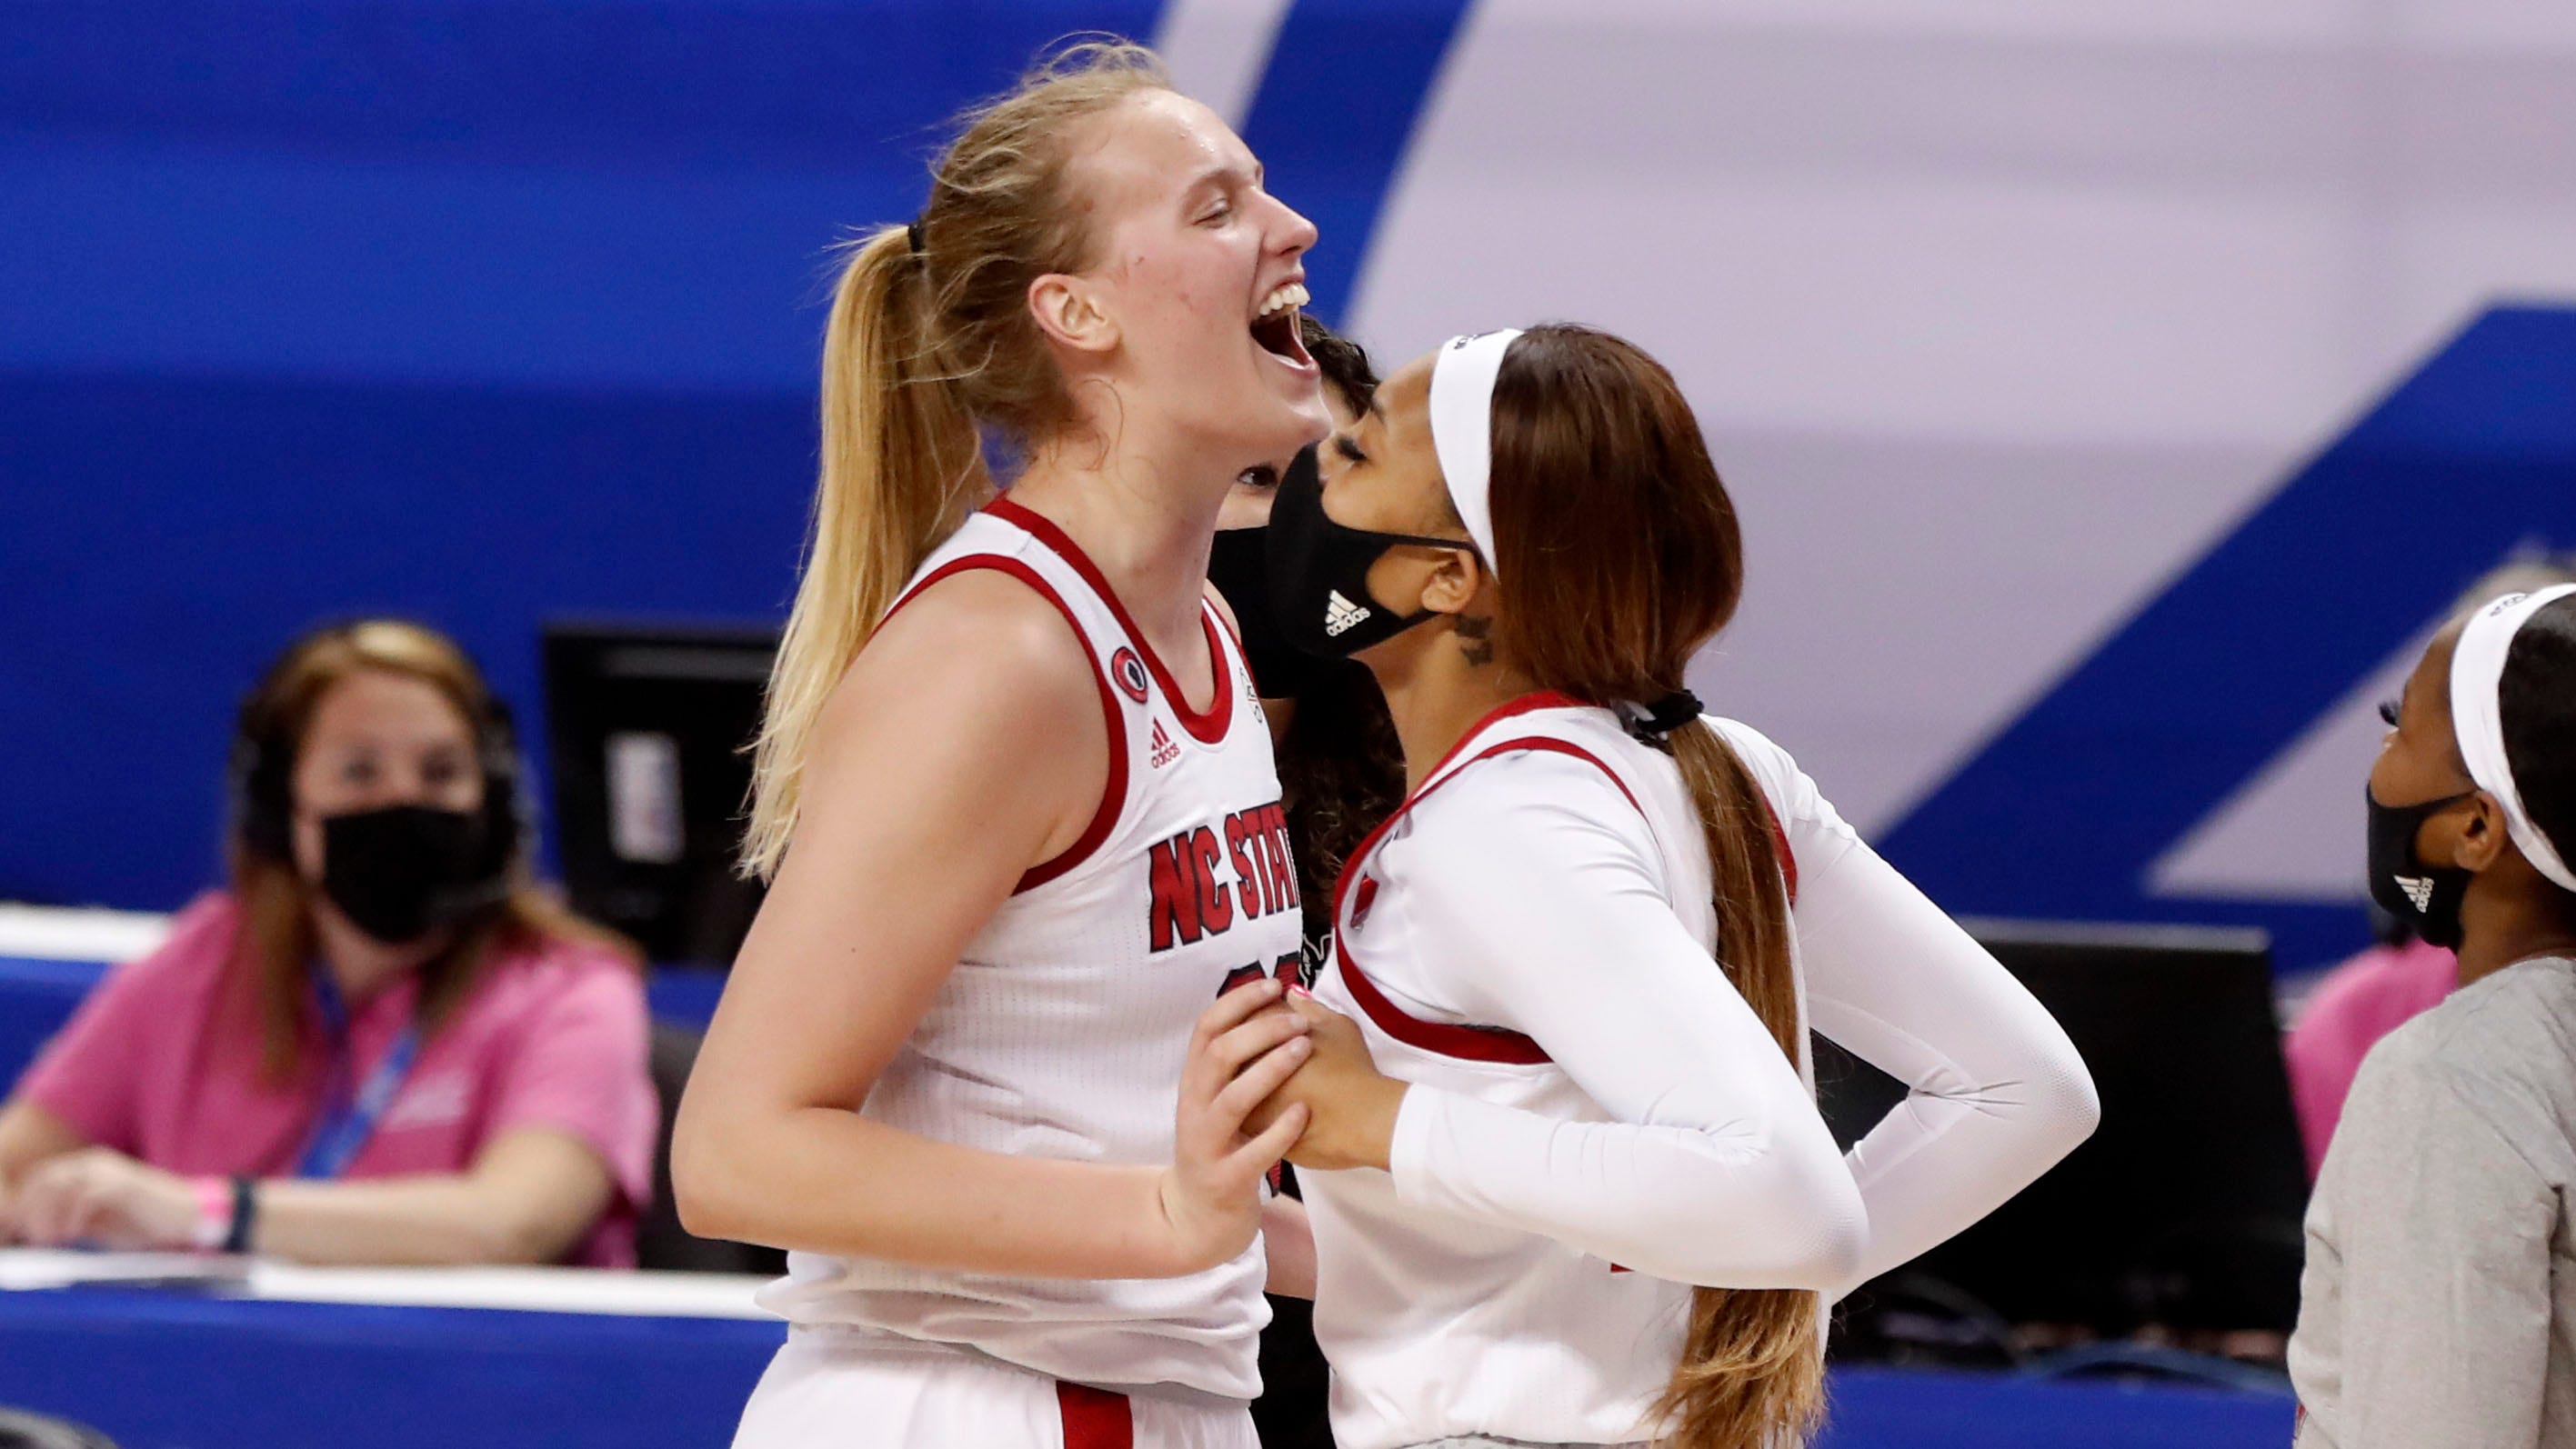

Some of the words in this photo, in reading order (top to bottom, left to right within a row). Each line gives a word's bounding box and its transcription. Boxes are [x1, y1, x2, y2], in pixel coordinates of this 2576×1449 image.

[1327, 607, 1370, 636] adidas
[1151, 742, 1180, 769] adidas
[1149, 824, 1233, 954] NC
